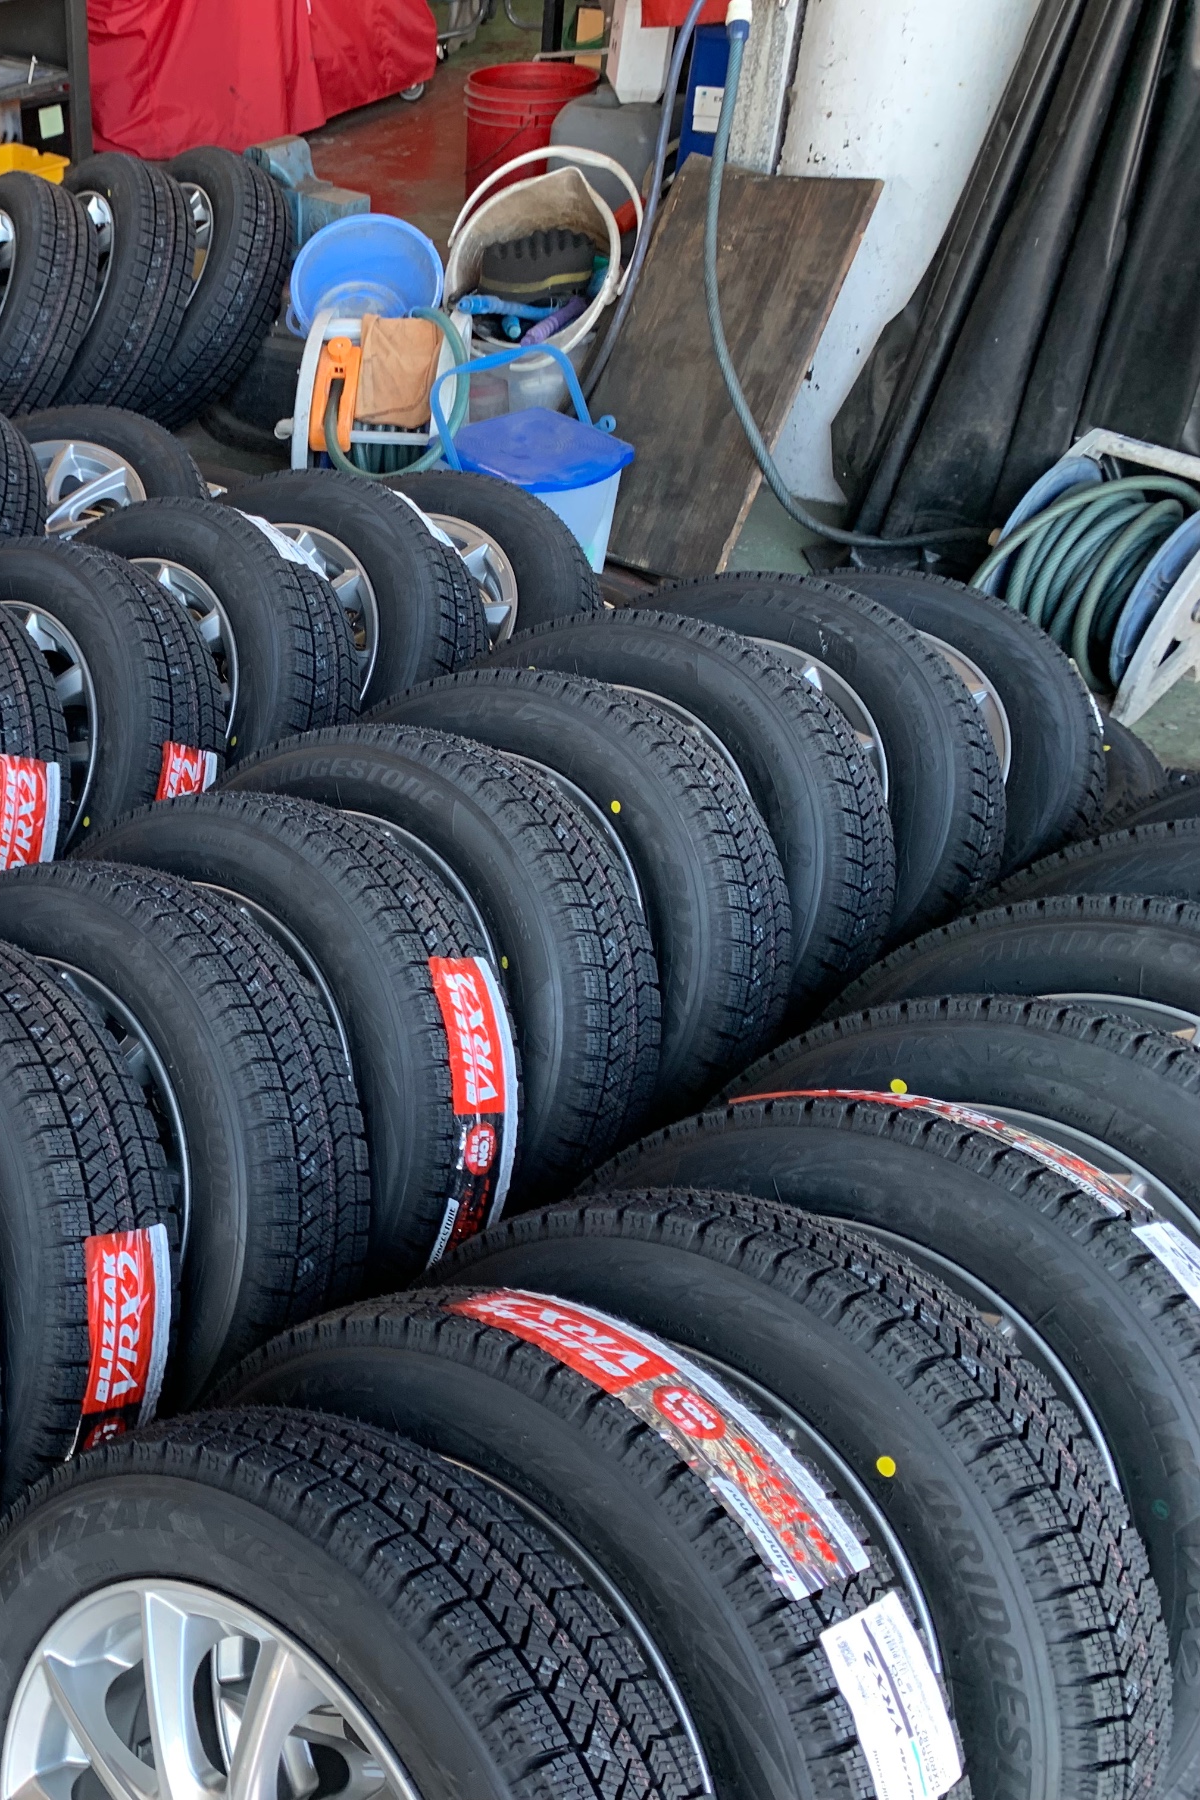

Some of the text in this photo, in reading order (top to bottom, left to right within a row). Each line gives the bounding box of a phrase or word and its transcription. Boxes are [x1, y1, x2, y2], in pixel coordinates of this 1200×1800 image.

[10, 768, 37, 869] VRX2
[454, 972, 499, 1102] VRX2
[477, 1130, 488, 1167] NO.1
[95, 1249, 117, 1403] BLIZZAK
[111, 1250, 139, 1399] VRX2
[490, 1298, 649, 1374] VRX2
[665, 1390, 717, 1431] NO.1
[0, 1497, 184, 1603] BLIZZAK
[863, 1650, 903, 1737] VRX2
